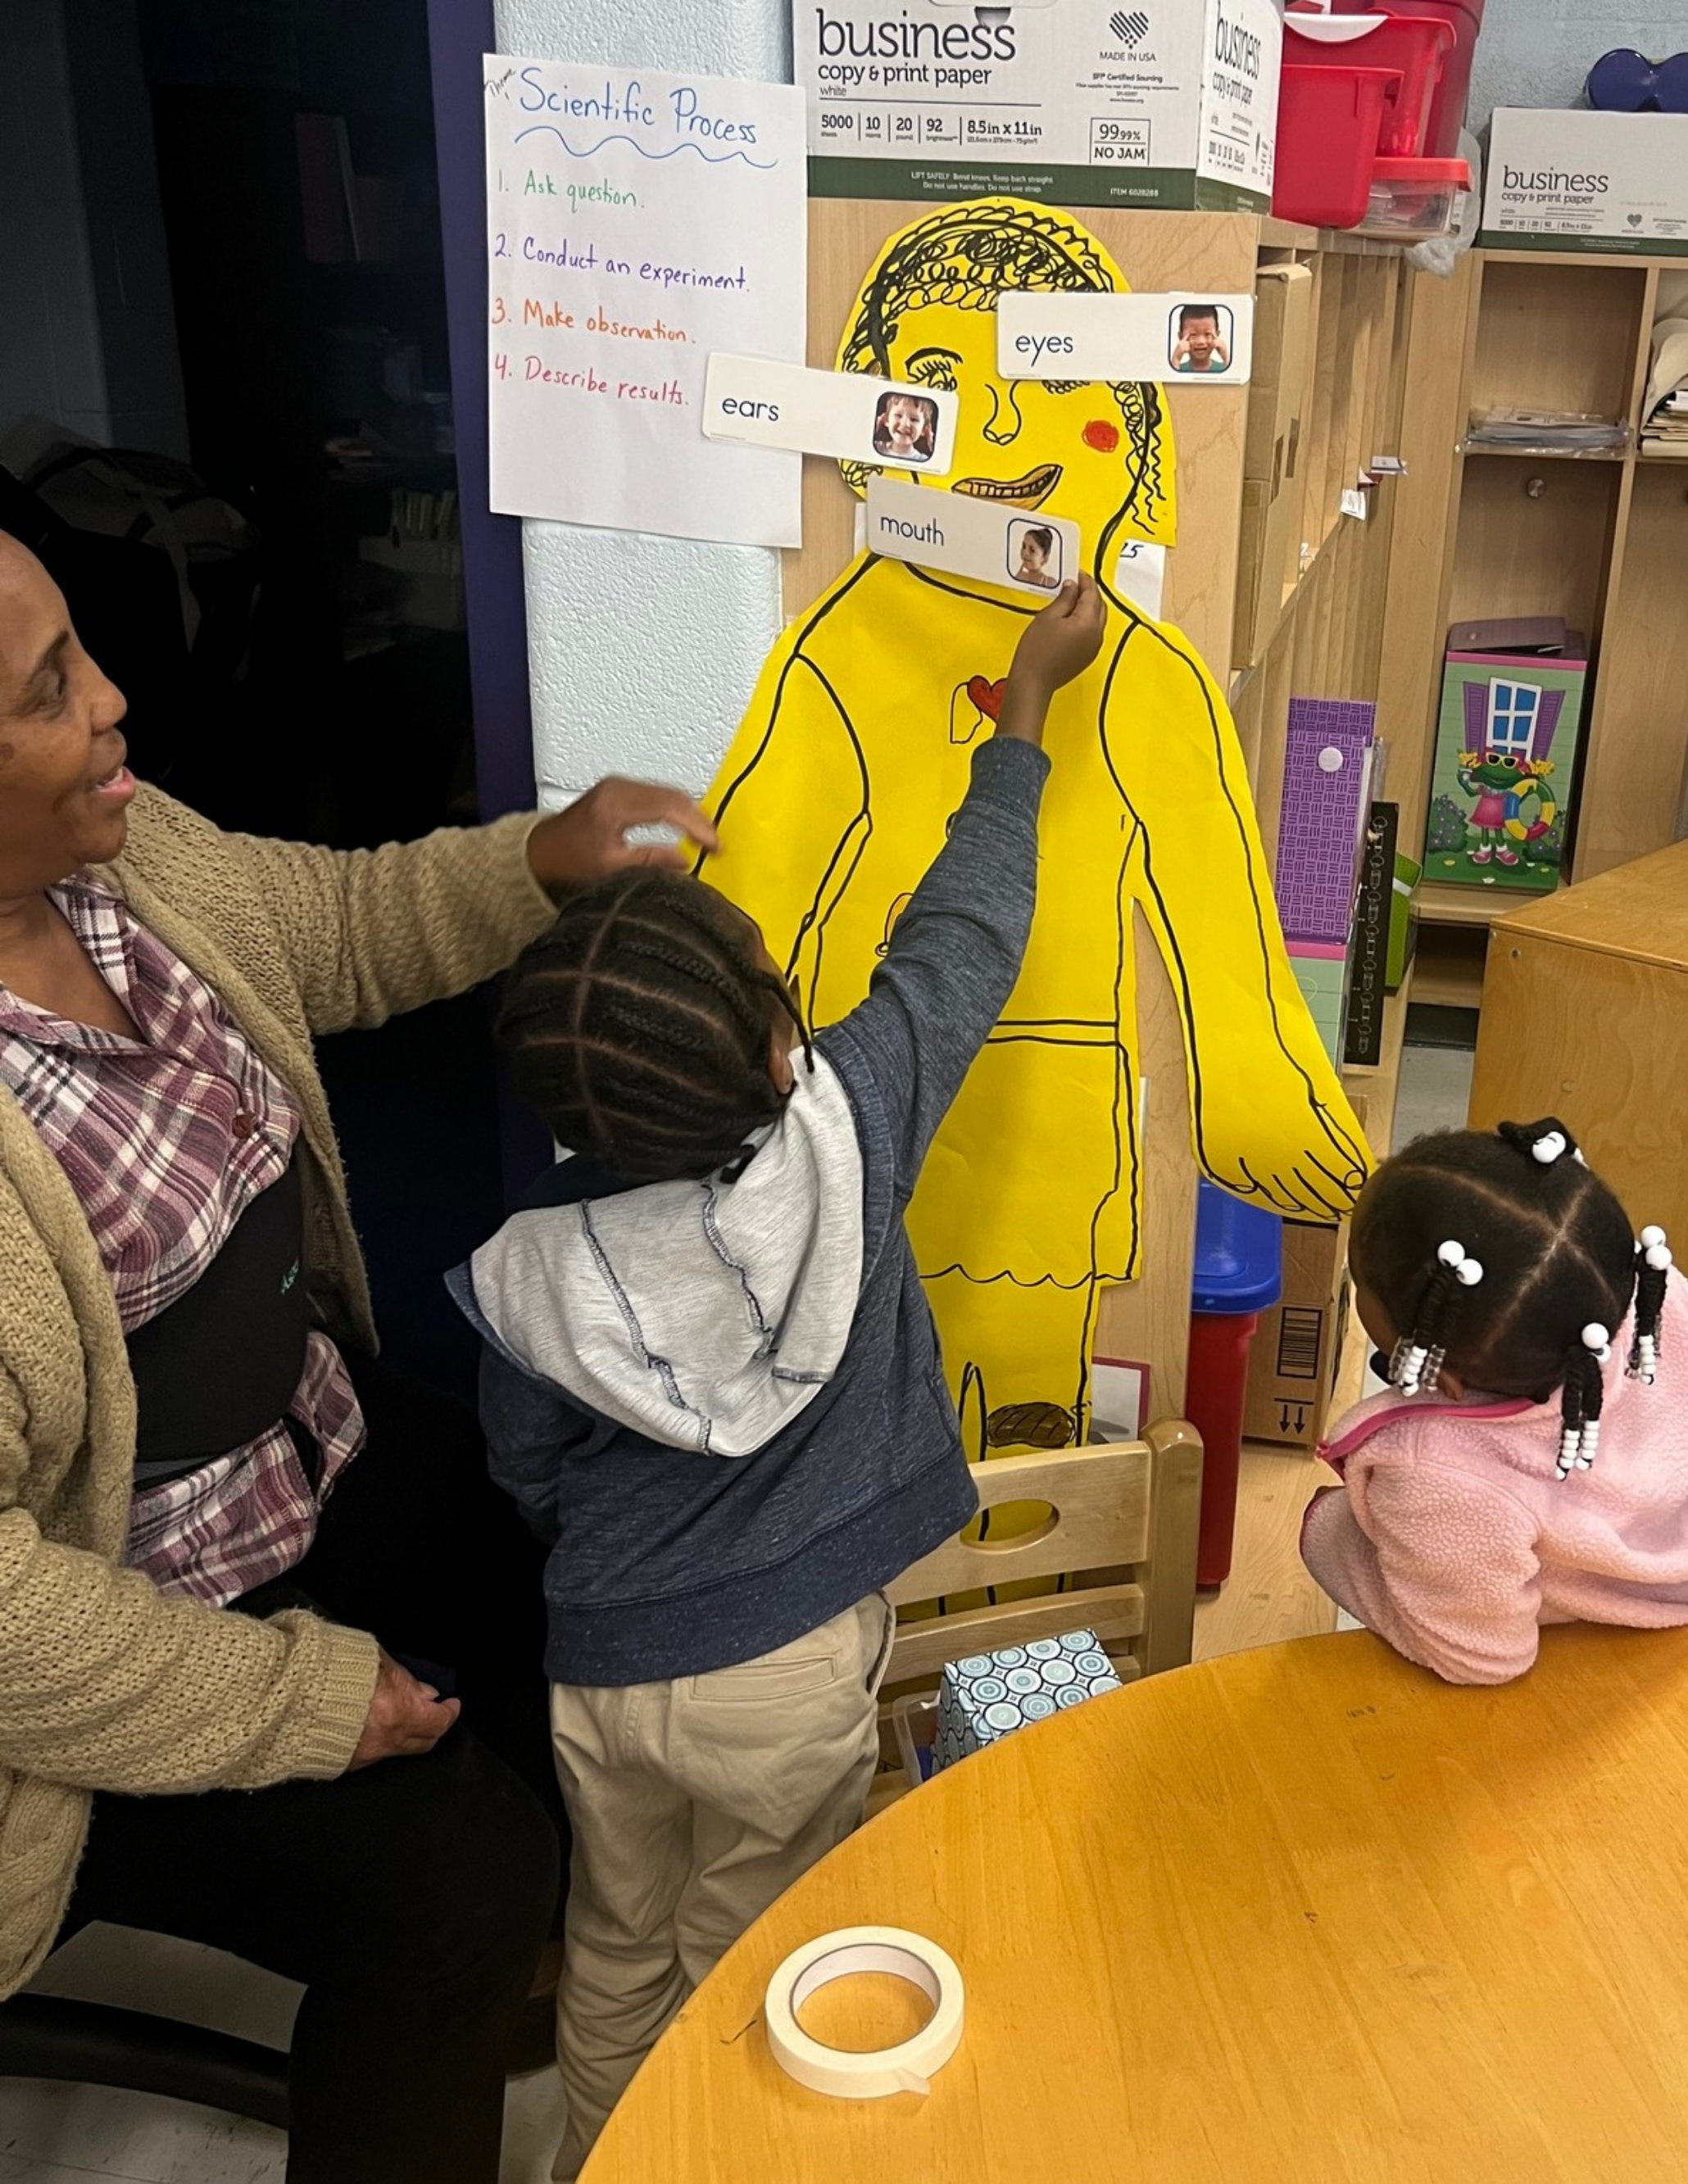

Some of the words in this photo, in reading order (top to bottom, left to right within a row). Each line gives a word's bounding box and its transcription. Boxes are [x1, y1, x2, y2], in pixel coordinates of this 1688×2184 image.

[816, 8, 1016, 61] business
[1100, 51, 1125, 61] MADE
[1128, 52, 1137, 61] IN
[1139, 52, 1156, 61] USA
[819, 65, 865, 85] copy
[869, 66, 879, 81] &
[883, 63, 929, 86] print
[935, 67, 992, 88] paper
[819, 85, 846, 97] white
[520, 67, 656, 125] Scientific
[669, 88, 757, 143] Process
[821, 114, 853, 129] 5000
[865, 116, 881, 130] 10
[896, 117, 913, 131] 20
[926, 118, 942, 132] 92
[1003, 124, 1012, 134] x
[1094, 147, 1114, 159] NO
[1117, 147, 1146, 160] JAM
[911, 171, 925, 179] LIFT
[1503, 165, 1609, 193] business
[498, 170, 510, 191] 1.
[524, 170, 557, 196] Ask
[567, 178, 646, 213] question.
[1110, 188, 1127, 196] ITEM
[1501, 193, 1527, 204] copy
[1536, 193, 1561, 204] print
[1563, 195, 1594, 206] paper
[495, 233, 511, 258] 2.
[523, 237, 599, 269] Conduct
[606, 261, 631, 275] an
[639, 266, 751, 292] experiment.
[492, 297, 512, 324] 3.
[524, 298, 574, 328] Make
[587, 306, 697, 344] observation.
[1014, 335, 1073, 368] eyes
[494, 354, 513, 380] 4.
[524, 355, 607, 393] Describe
[618, 380, 689, 406] results.
[721, 397, 779, 422] ears
[880, 516, 945, 546] mouth
